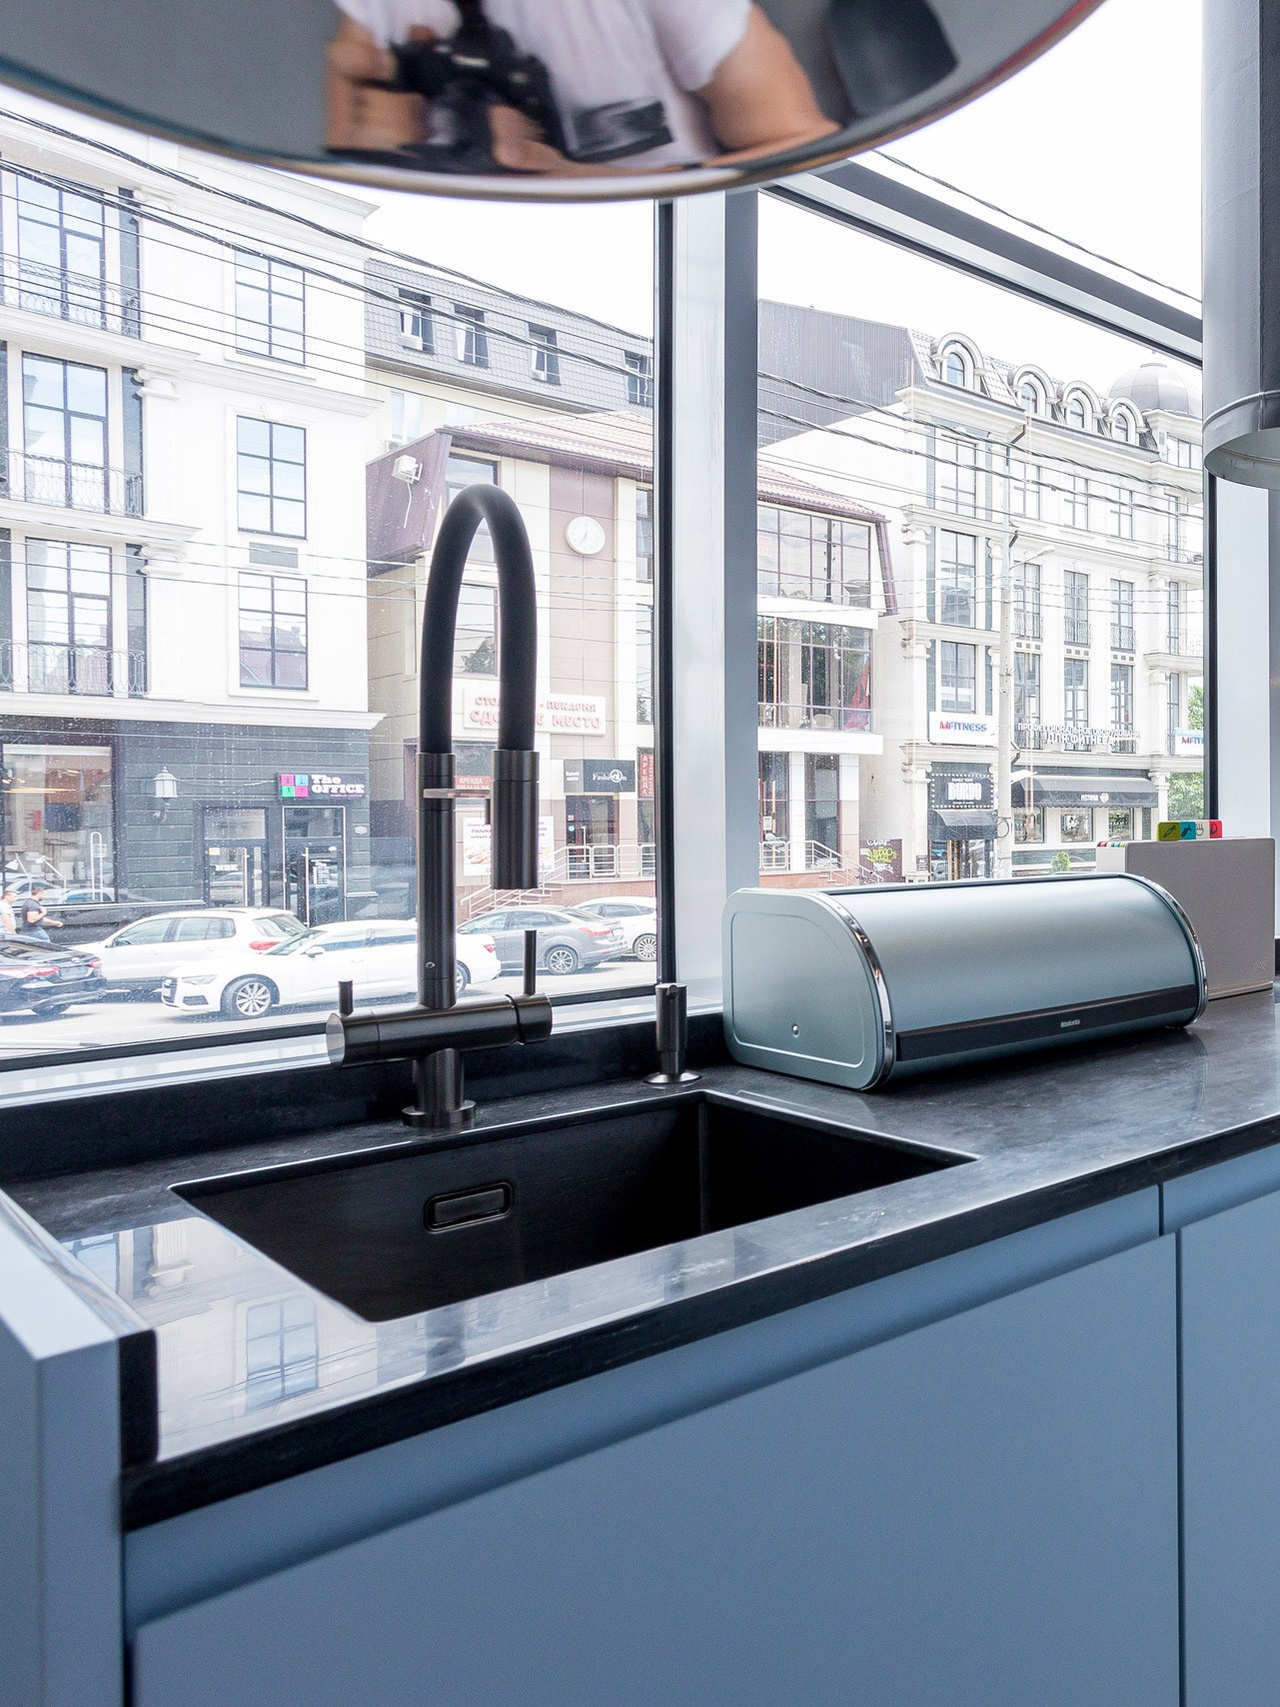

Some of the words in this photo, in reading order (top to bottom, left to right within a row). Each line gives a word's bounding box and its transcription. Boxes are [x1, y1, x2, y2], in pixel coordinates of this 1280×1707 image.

[546, 701, 596, 712] ПЕКАРНЯ
[552, 715, 600, 728] МЕСТО
[940, 721, 987, 732] MFITNESS
[311, 774, 341, 784] The
[311, 784, 364, 794] OFFICE
